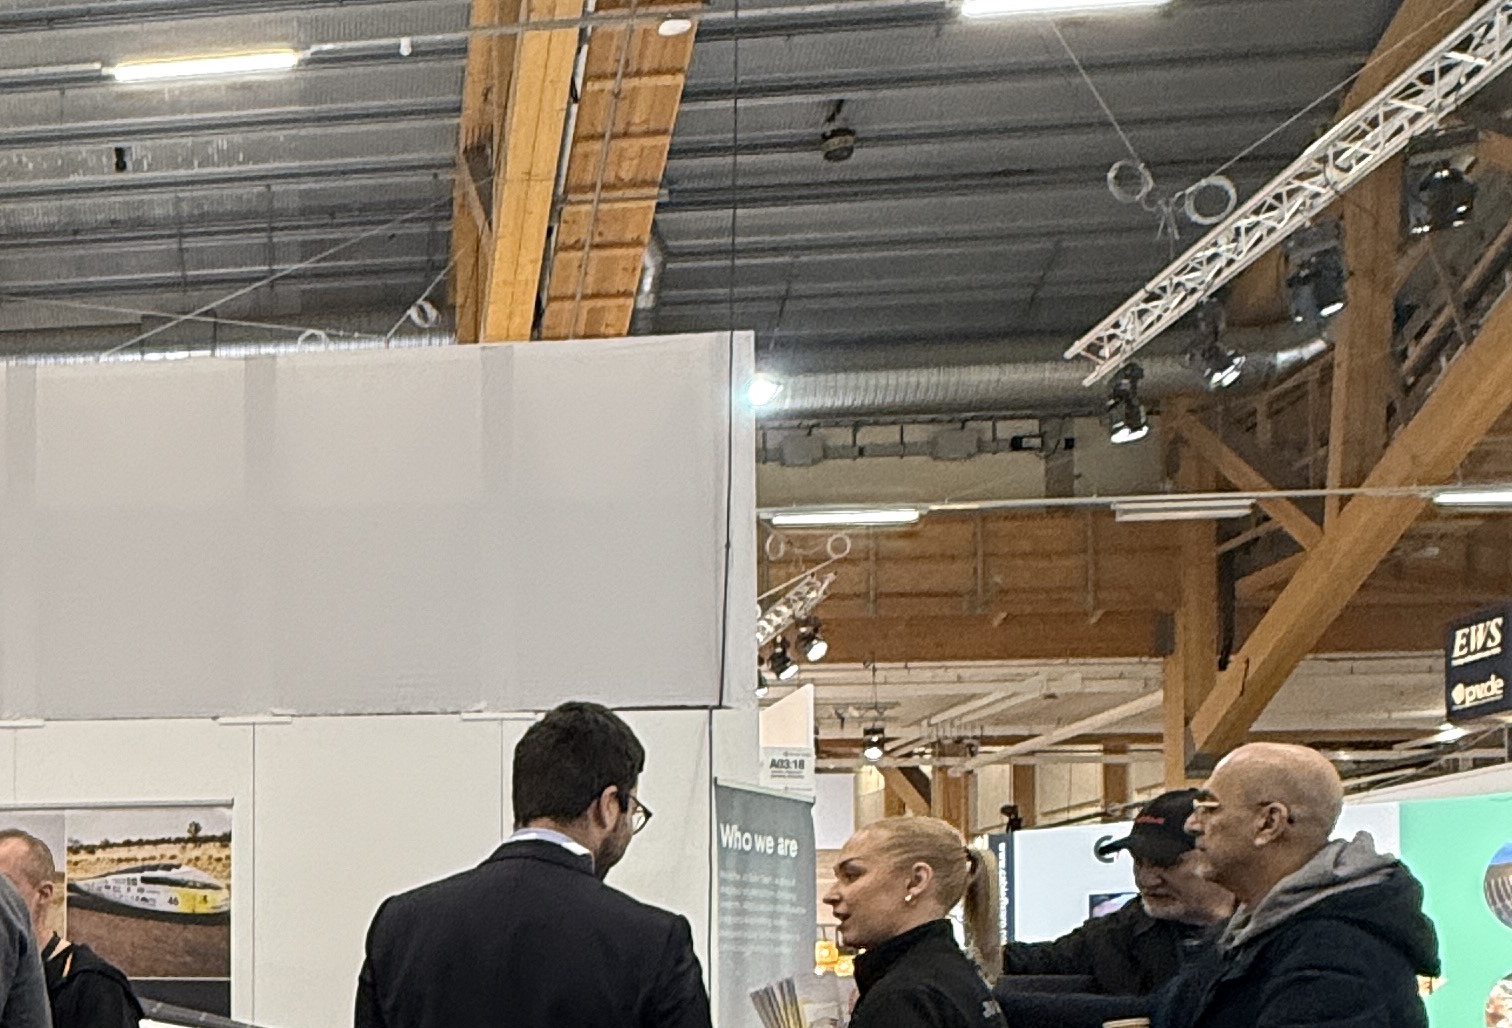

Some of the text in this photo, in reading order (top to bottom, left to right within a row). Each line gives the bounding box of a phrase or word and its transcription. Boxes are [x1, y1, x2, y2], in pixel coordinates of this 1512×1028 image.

[1451, 617, 1504, 658] EWS
[719, 823, 799, 858] Who we are
